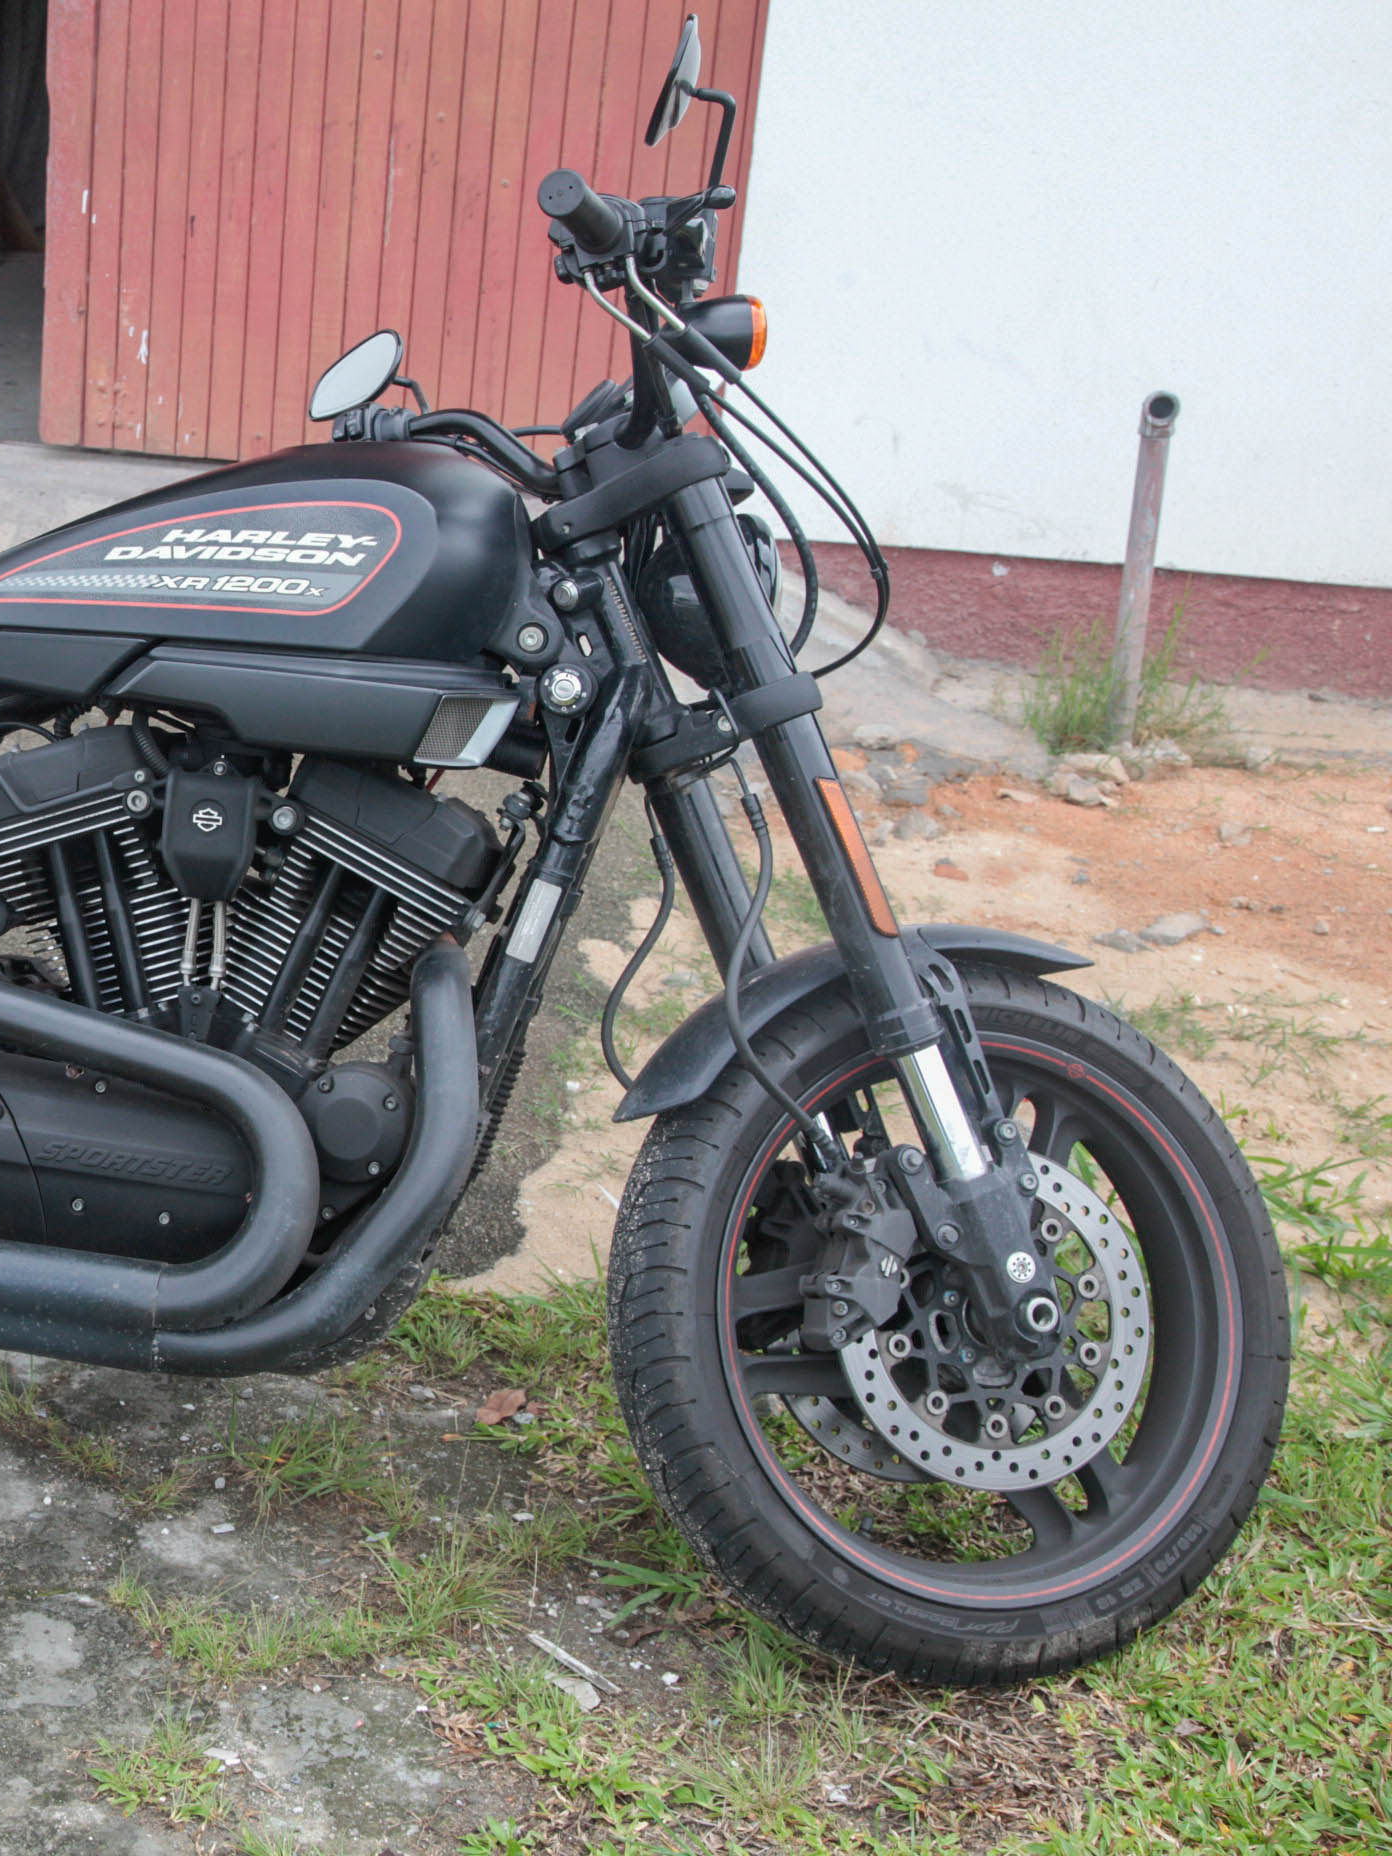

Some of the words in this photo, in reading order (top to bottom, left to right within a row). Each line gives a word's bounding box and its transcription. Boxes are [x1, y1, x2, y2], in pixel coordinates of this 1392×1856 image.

[161, 528, 378, 549] HARLEY-
[104, 545, 368, 567] DAVIDSON
[34, 1142, 234, 1186] SPORTSTER
